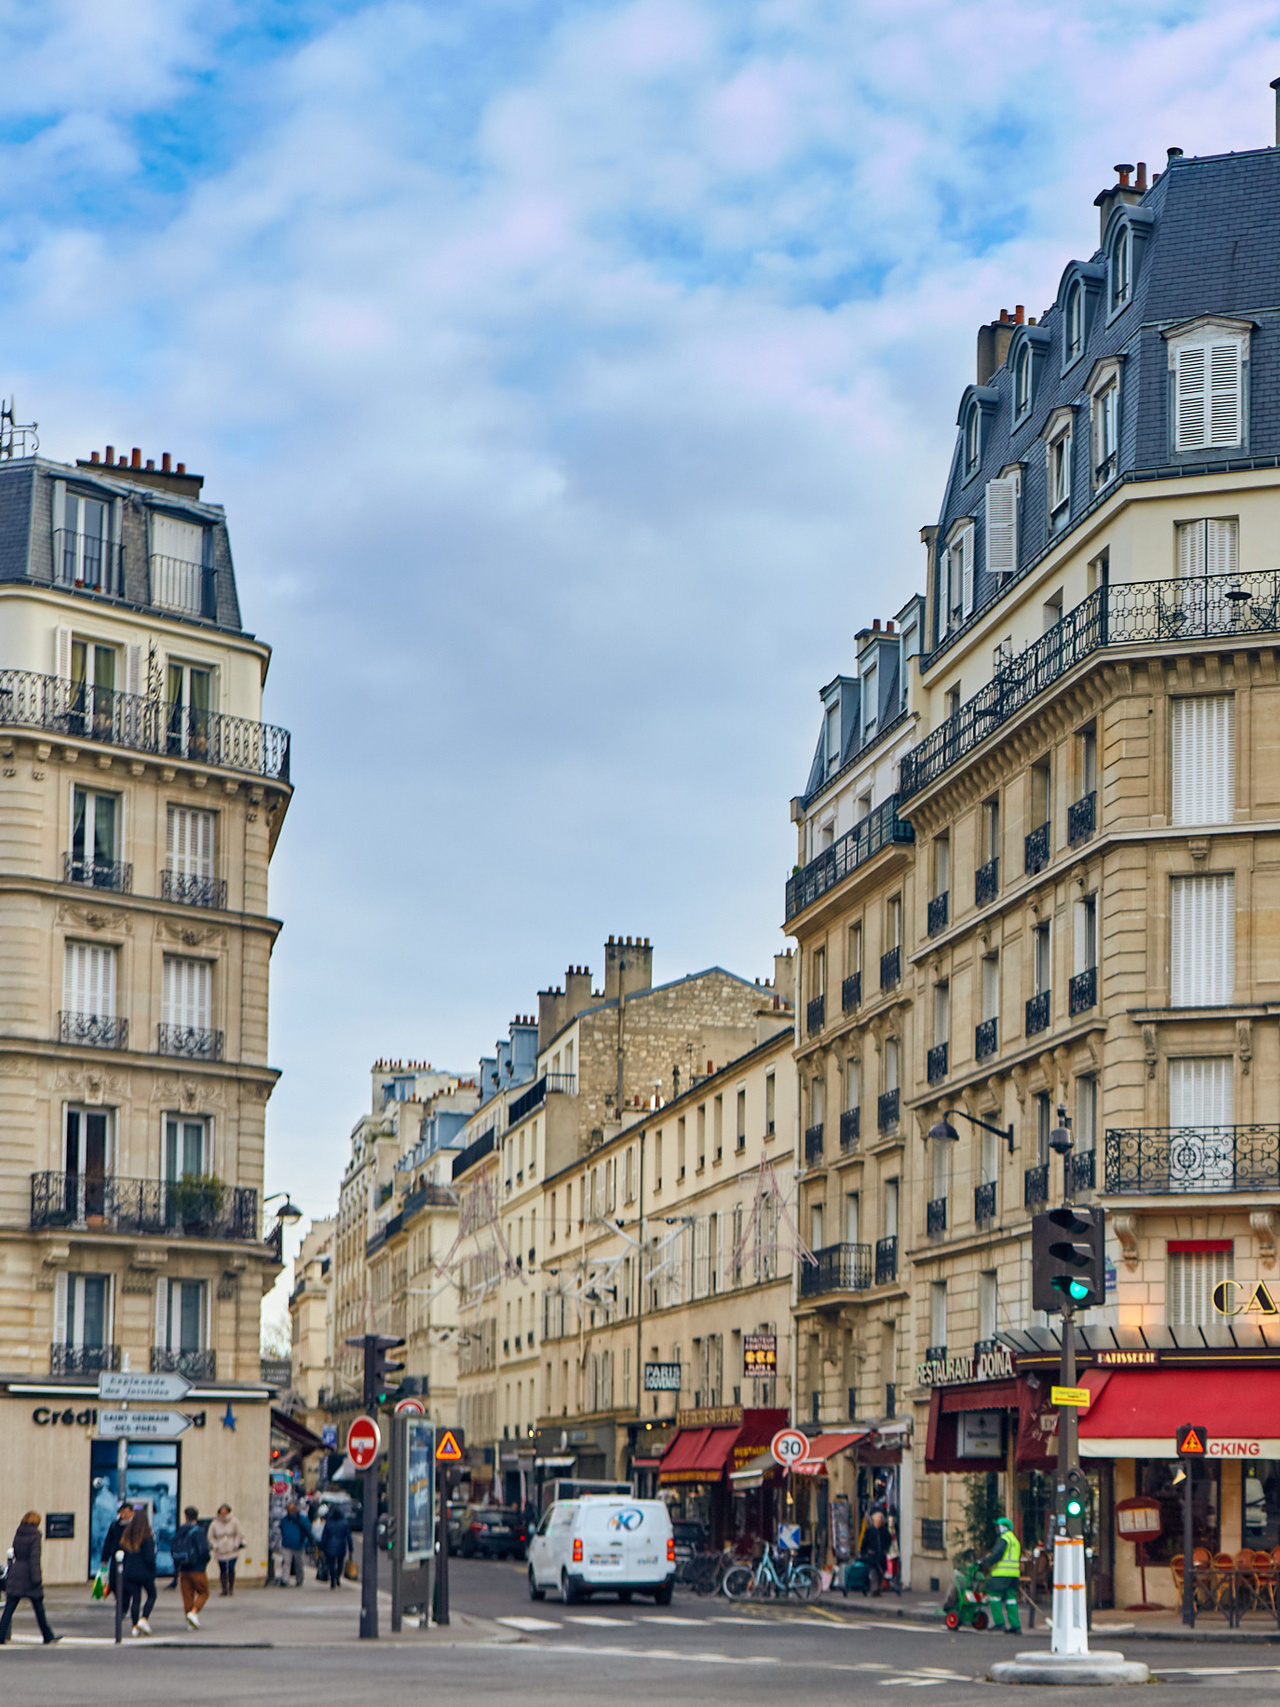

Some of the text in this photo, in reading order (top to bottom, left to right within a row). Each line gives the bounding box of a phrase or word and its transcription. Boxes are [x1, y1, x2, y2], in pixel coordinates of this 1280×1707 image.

[1098, 1352, 1157, 1364] PATISSERIE
[646, 1365, 681, 1378] PARIS
[917, 1351, 1013, 1385] RESTAURANT DOINA
[110, 1376, 166, 1386] Esplanade
[127, 1387, 170, 1396] Invalides
[32, 1406, 97, 1426] Crédi
[103, 1413, 170, 1423] SAINT GERMAIN
[780, 1440, 802, 1456] 30
